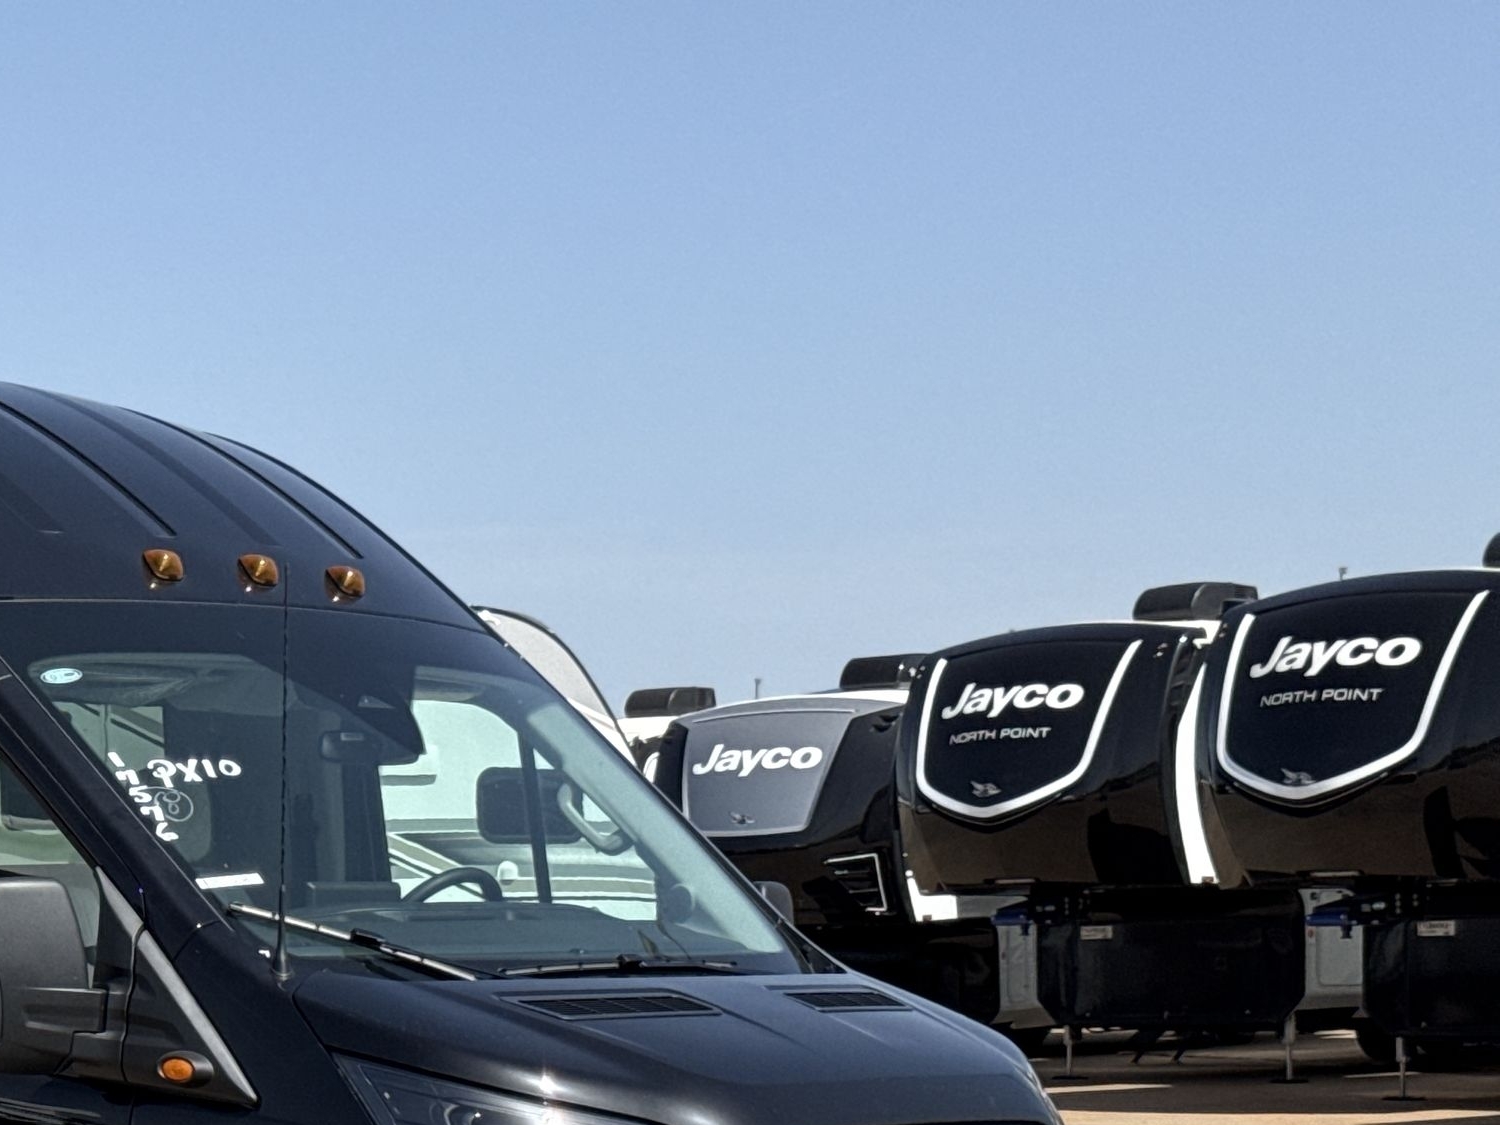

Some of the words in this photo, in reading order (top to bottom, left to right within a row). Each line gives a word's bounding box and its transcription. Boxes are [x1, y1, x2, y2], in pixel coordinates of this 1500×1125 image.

[1249, 635, 1422, 678] Jayco
[941, 682, 1085, 719] Jayco
[1260, 690, 1317, 707] NORTH
[1321, 687, 1384, 702] POINT
[949, 729, 997, 745] NORTH
[1000, 726, 1052, 739] POINT
[692, 743, 823, 777] Jayco
